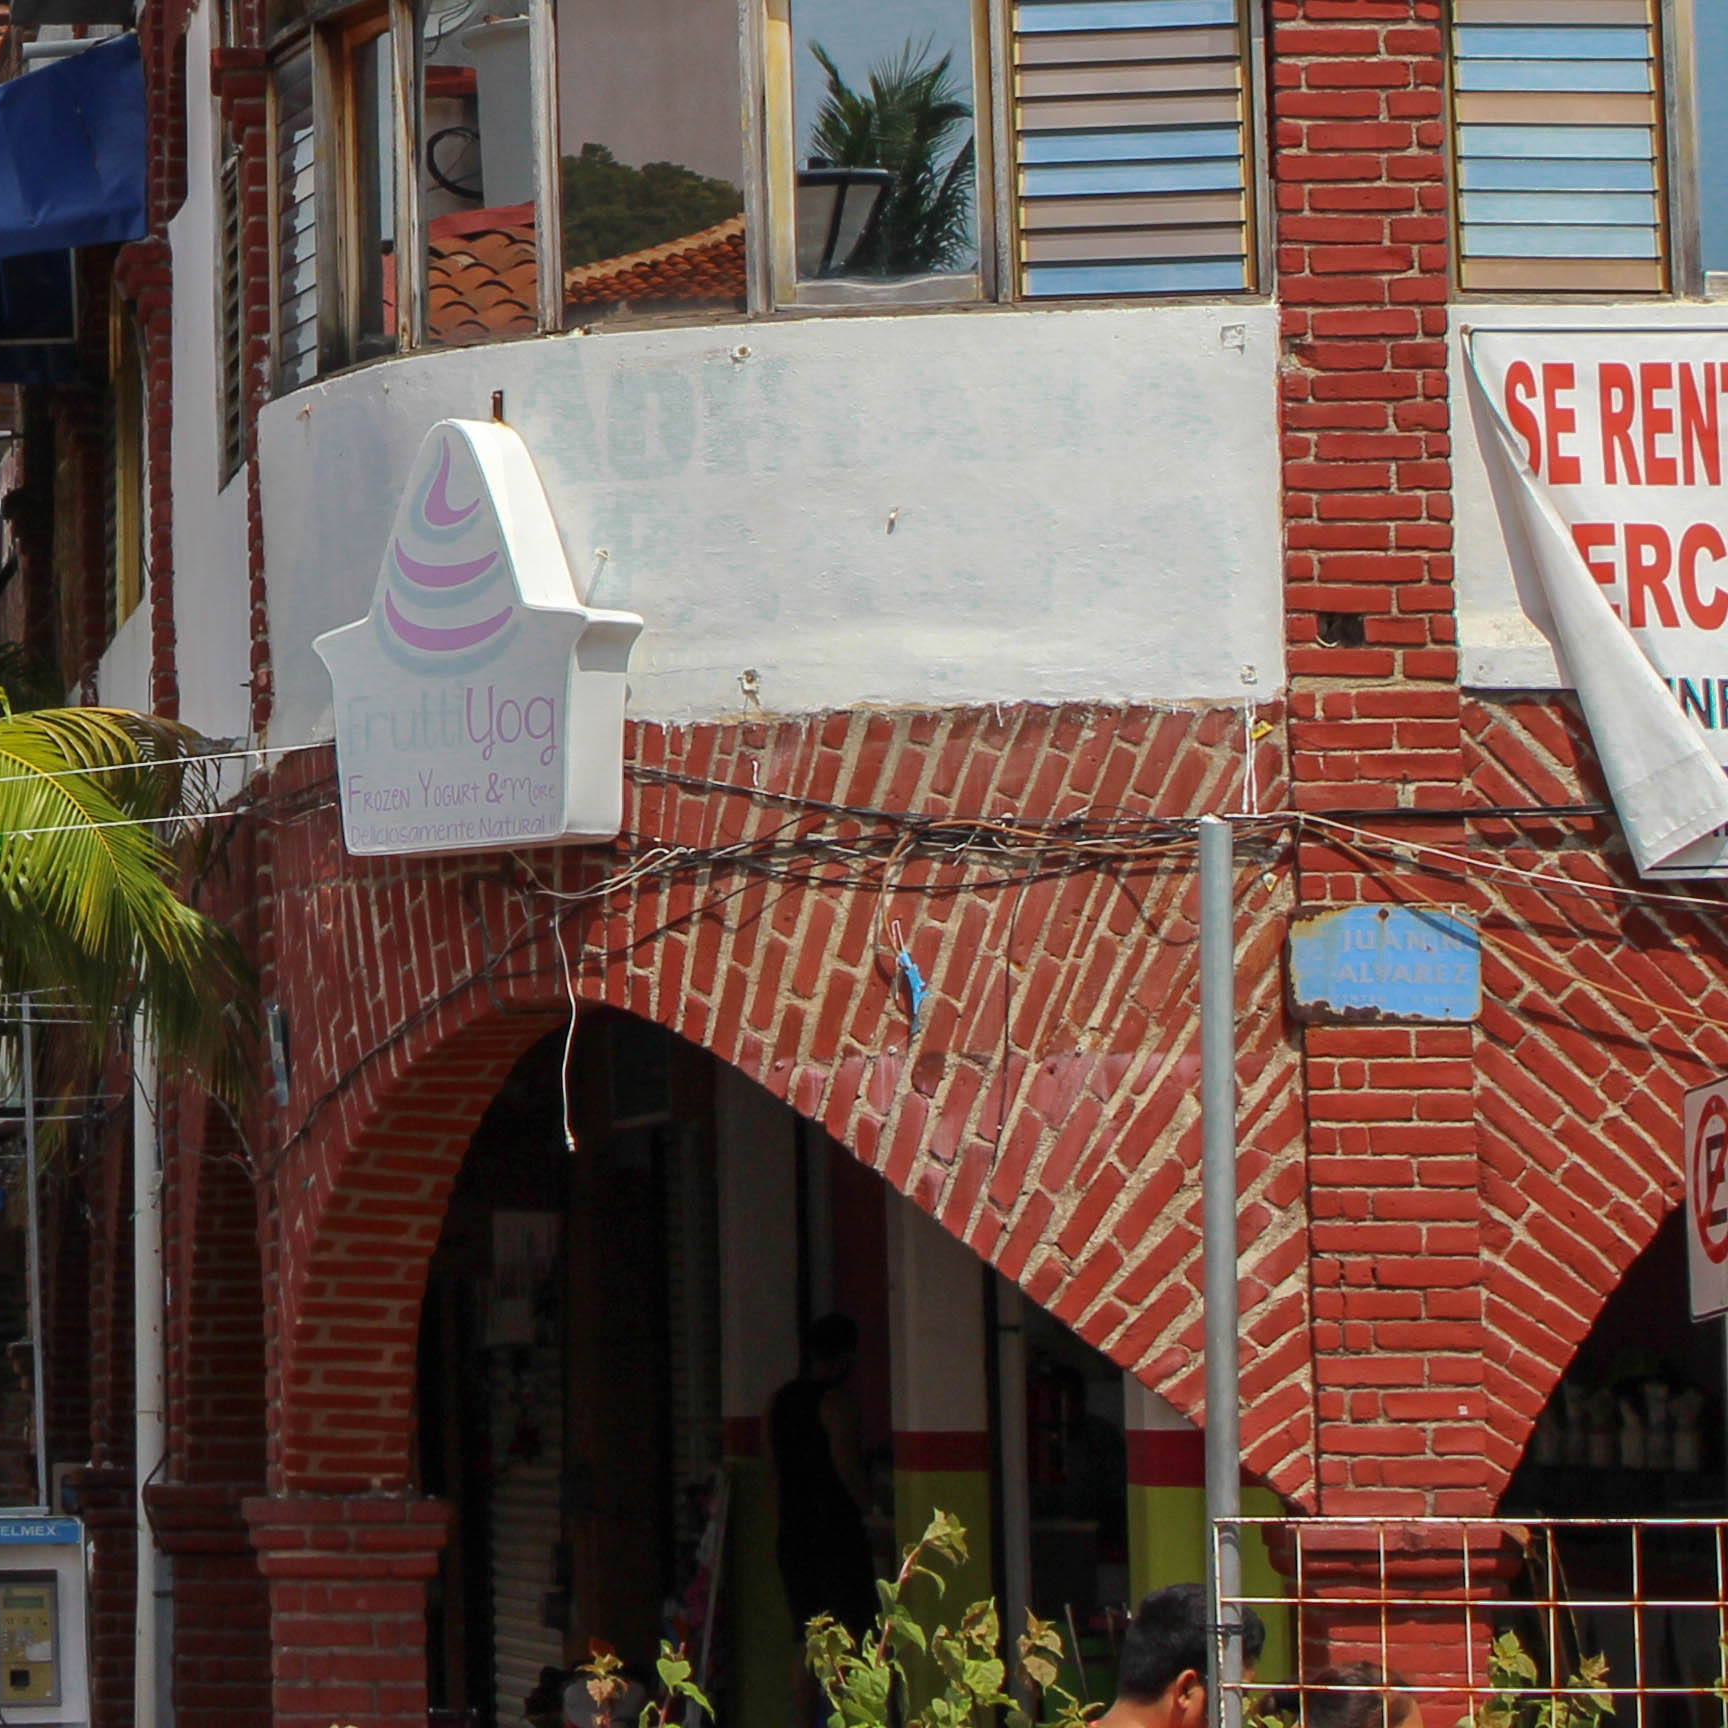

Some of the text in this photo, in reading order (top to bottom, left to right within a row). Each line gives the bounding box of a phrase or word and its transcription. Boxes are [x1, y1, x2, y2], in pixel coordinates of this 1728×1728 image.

[1504, 360, 1728, 485] SE REN
[1337, 929, 1430, 952] JUAN
[1335, 961, 1470, 984] ALVAREZ
